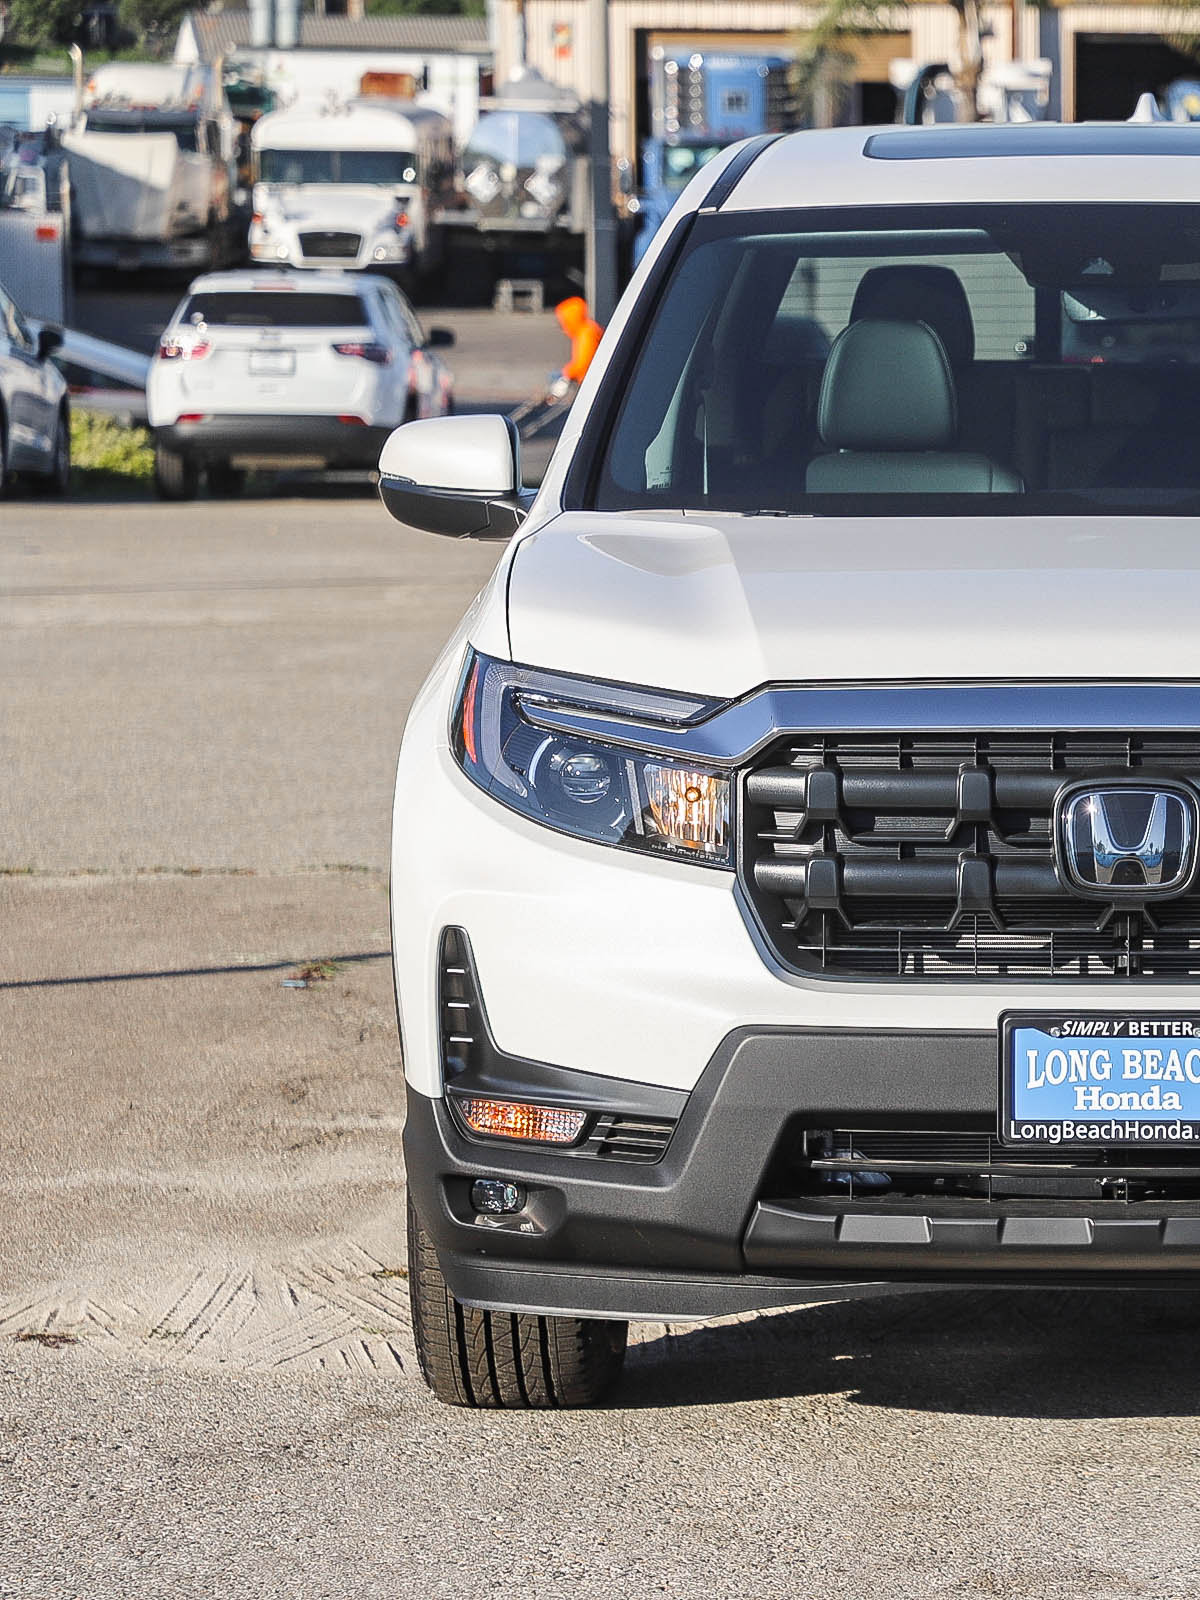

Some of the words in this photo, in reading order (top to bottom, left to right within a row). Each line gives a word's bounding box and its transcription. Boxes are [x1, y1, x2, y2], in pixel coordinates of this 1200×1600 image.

[1061, 1020, 1125, 1036] SIMPLY
[1128, 1021, 1193, 1036] BETTER
[1025, 1048, 1113, 1089] LONG
[1073, 1085, 1183, 1111] Honda
